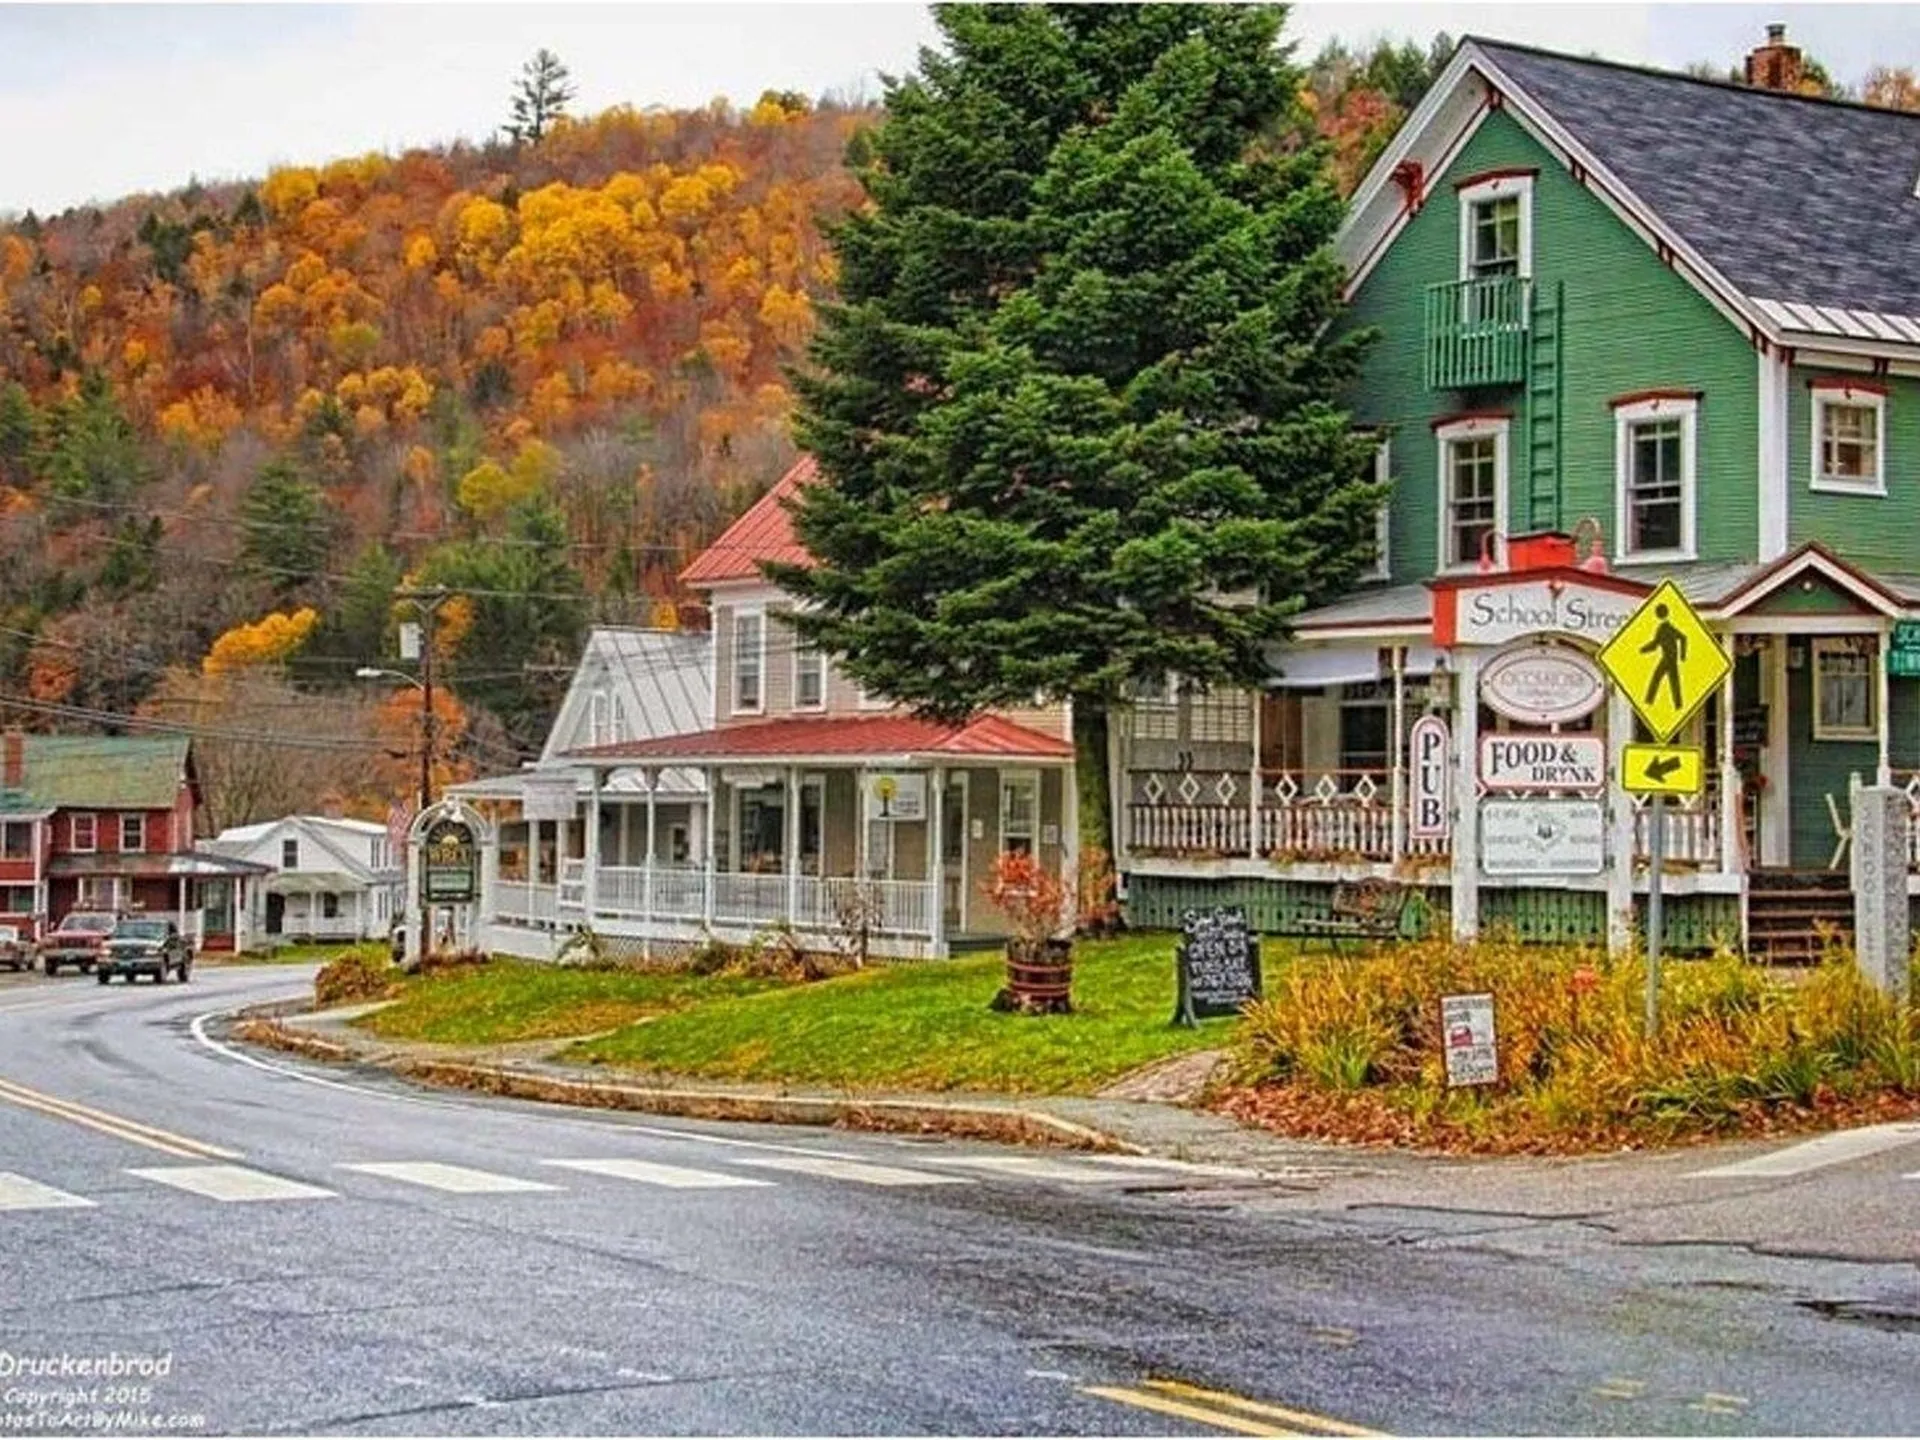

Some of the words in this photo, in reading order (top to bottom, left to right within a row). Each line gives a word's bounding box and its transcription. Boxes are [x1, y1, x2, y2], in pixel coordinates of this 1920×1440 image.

[1470, 592, 1558, 627] School
[1563, 598, 1631, 631] Stree
[1421, 732, 1441, 827] PUB
